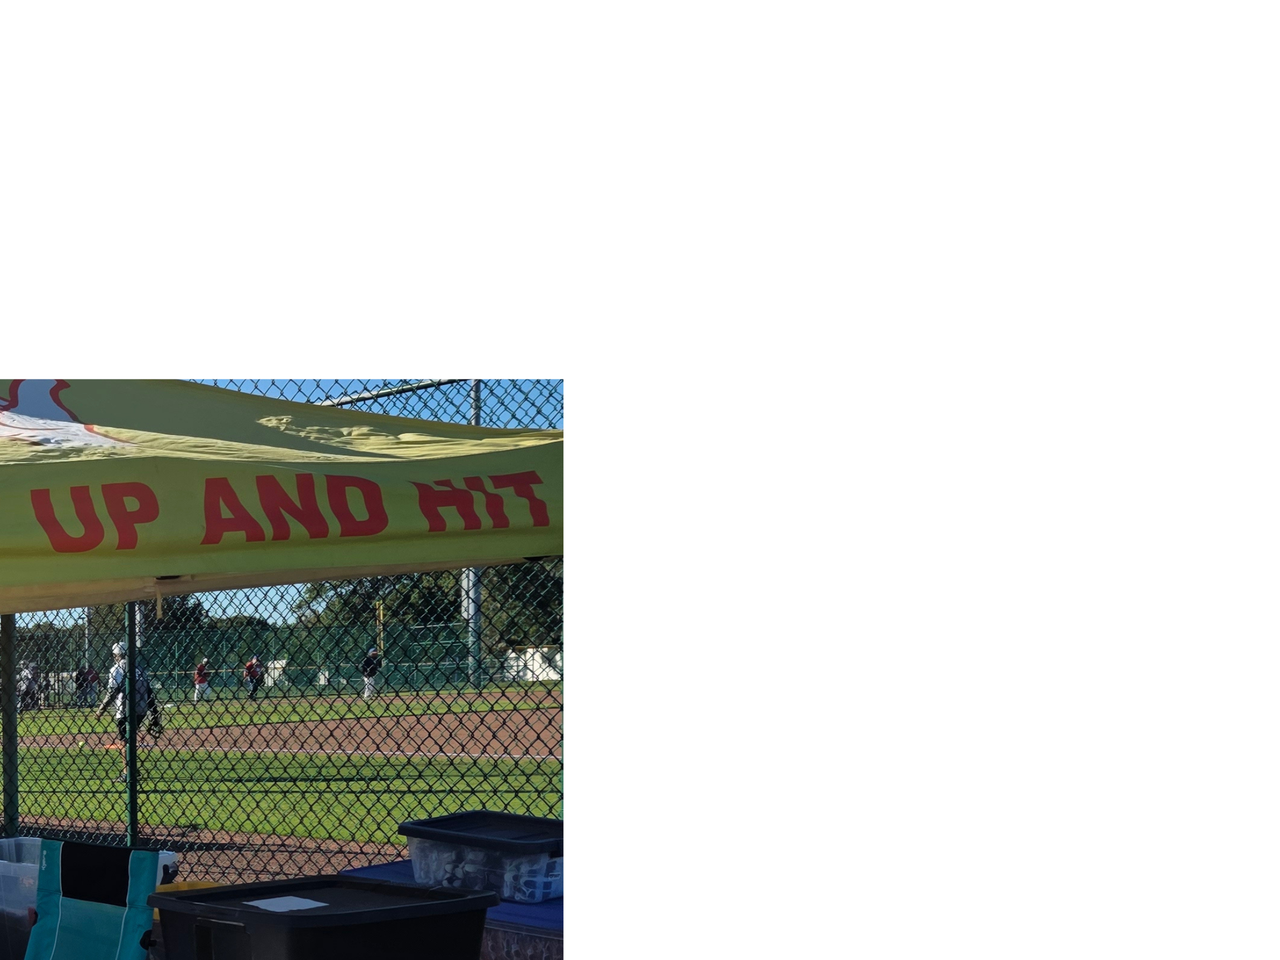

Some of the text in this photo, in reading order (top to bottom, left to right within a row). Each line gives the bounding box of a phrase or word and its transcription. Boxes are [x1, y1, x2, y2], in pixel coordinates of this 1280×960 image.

[30, 481, 160, 553] UP
[201, 473, 389, 546] AND
[408, 470, 551, 533] HIT
